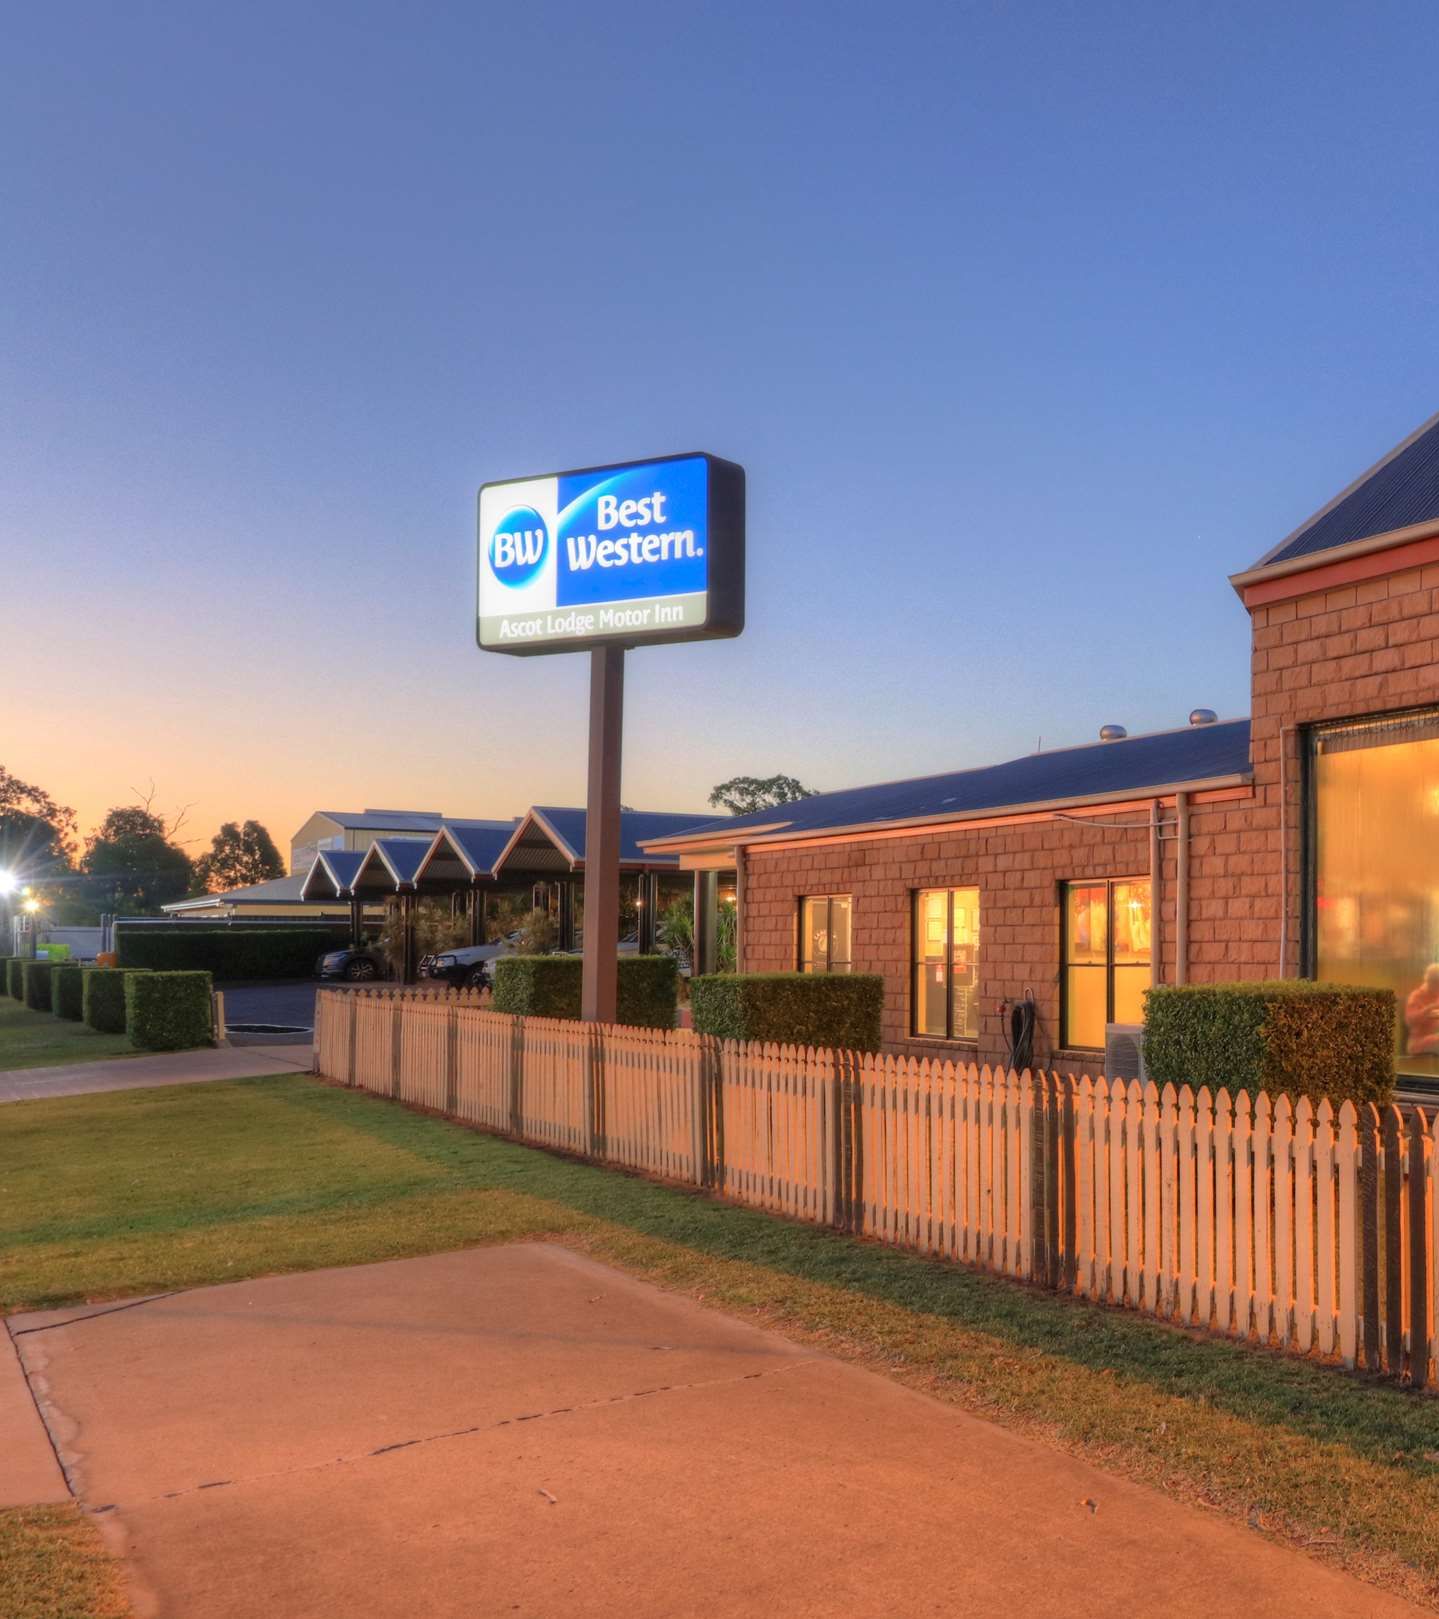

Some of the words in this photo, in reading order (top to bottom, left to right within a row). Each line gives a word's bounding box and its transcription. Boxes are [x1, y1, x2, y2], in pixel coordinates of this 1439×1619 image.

[597, 491, 666, 530] Best
[494, 529, 544, 568] BW
[500, 619, 542, 638] Ascot
[547, 612, 594, 635] Lodge
[600, 606, 650, 628] Motor
[655, 603, 684, 623] Inn
